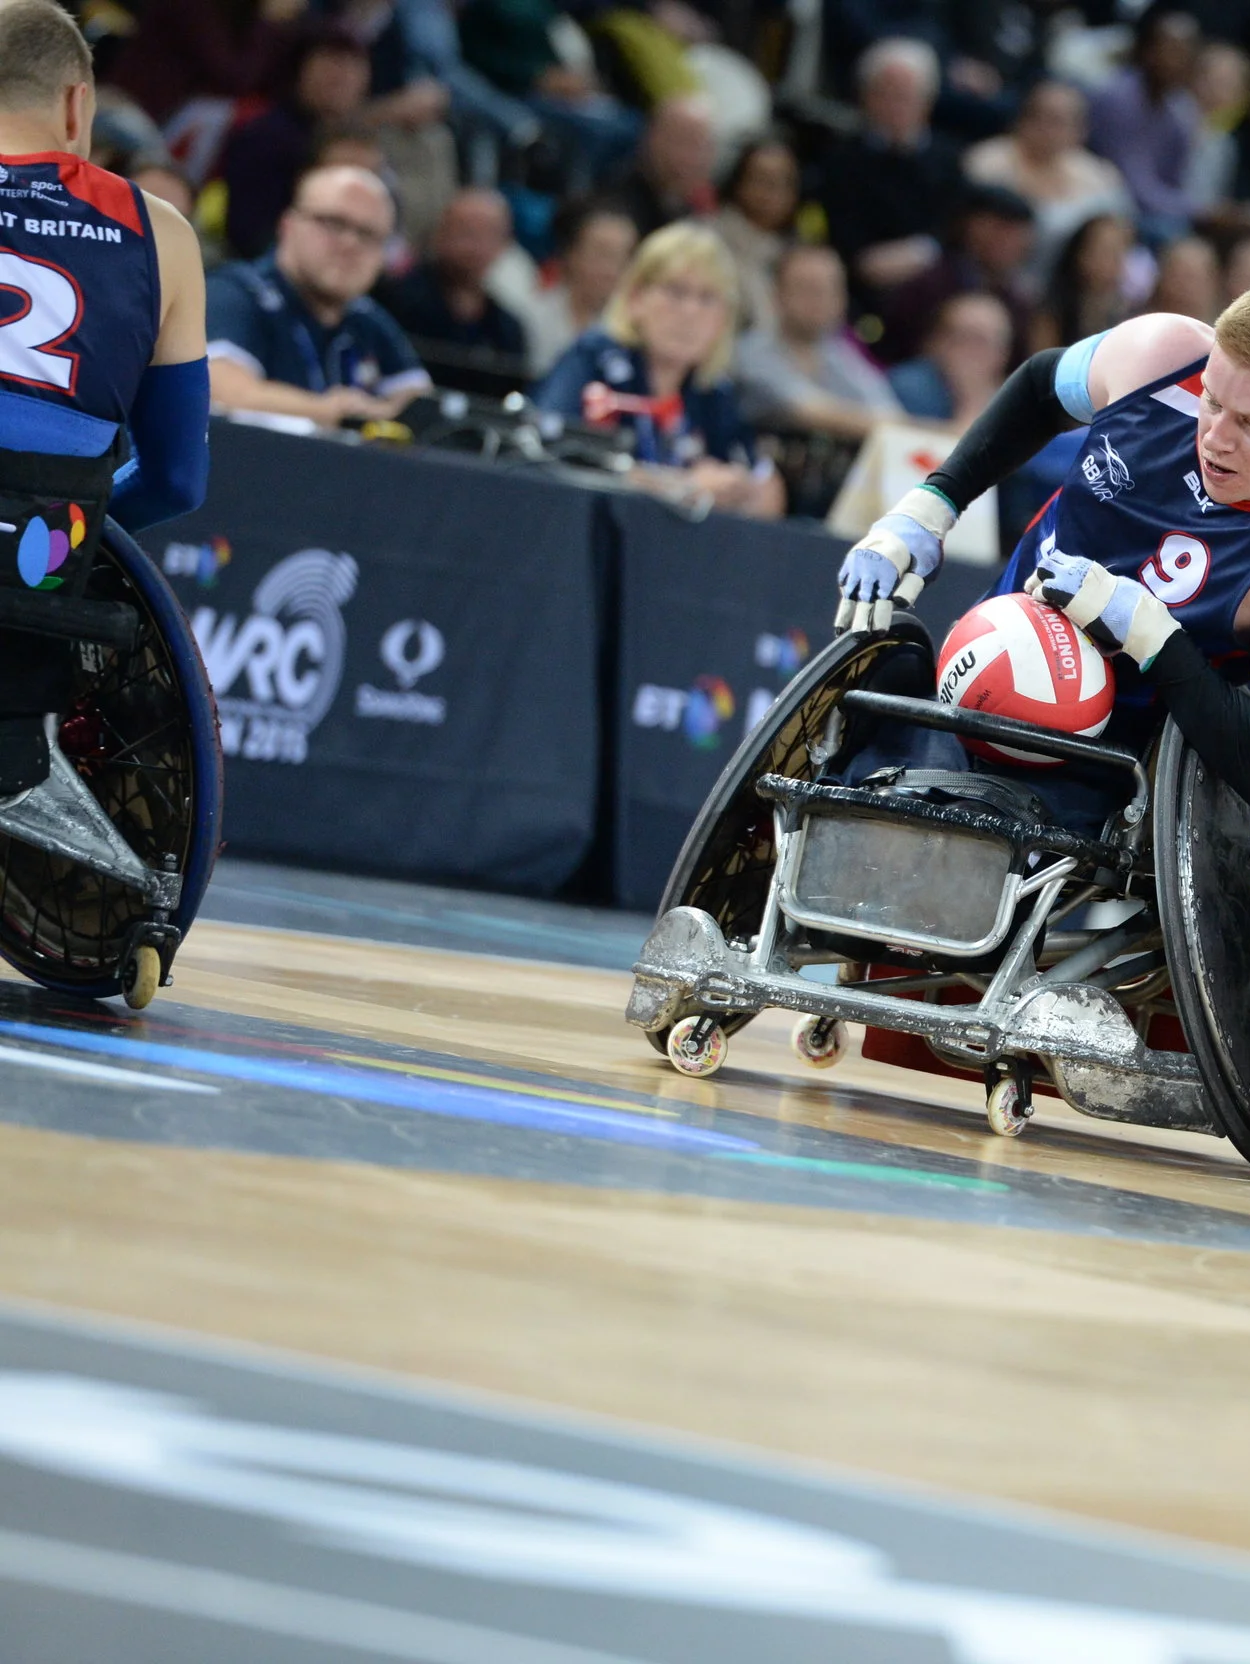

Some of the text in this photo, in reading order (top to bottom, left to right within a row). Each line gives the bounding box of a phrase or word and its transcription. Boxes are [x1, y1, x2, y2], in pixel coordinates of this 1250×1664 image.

[31, 181, 63, 191] sport
[24, 218, 122, 243] BRITAIN
[0, 246, 85, 397] 2
[1081, 454, 1114, 502] GBWR
[1183, 470, 1214, 514] BLK
[1137, 530, 1211, 608] 9
[1044, 613, 1078, 681] LONDON
